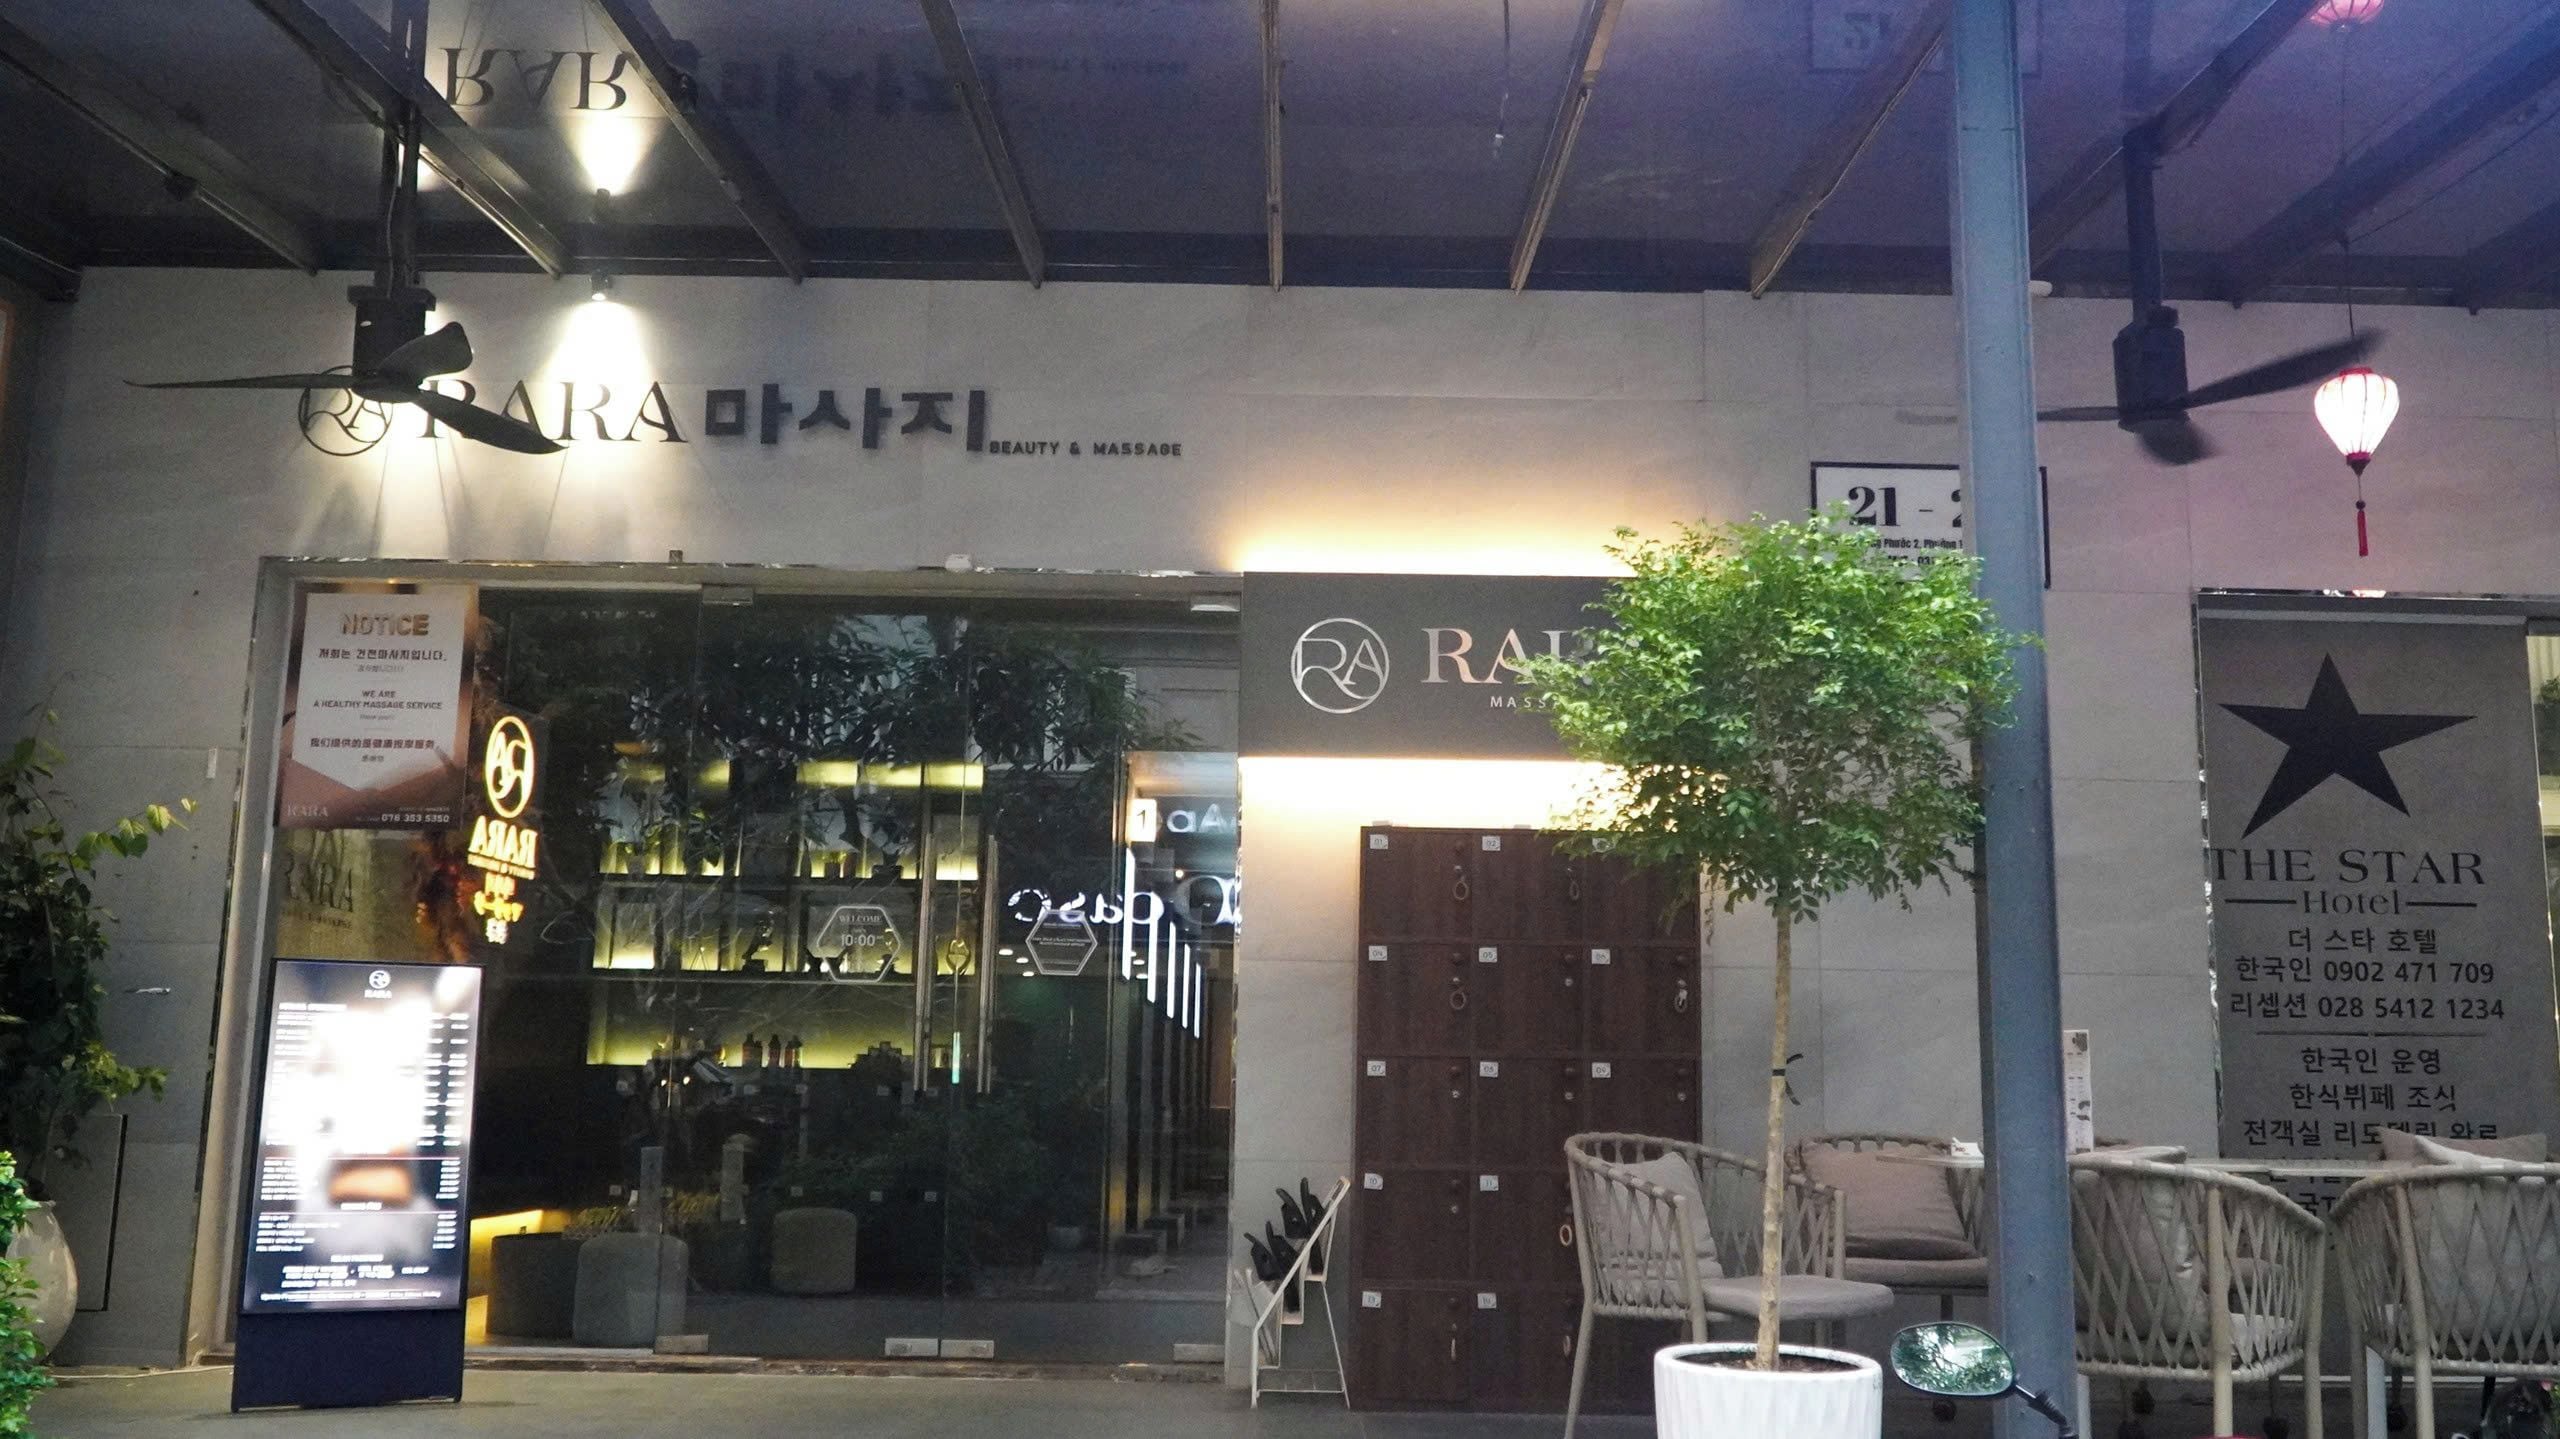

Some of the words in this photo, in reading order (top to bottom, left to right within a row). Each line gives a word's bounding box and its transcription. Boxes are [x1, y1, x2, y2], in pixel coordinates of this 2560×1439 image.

[705, 383, 986, 452] 마사지
[989, 440, 1060, 455] BEAUTY
[1069, 441, 1081, 455] &
[1093, 442, 1182, 457] MASSAGE
[1848, 486, 1901, 526] 21
[342, 613, 430, 636] NOTICE
[313, 700, 320, 708] A
[321, 700, 362, 709] HEALTHY
[363, 701, 404, 709] MASSAGE
[406, 701, 443, 710] SERVICE
[362, 690, 376, 698] WE
[378, 691, 396, 699] ARE
[2206, 848, 2315, 883] THE
[2338, 849, 2485, 885] STAR
[2302, 889, 2401, 915] Hotel
[841, 934, 876, 947] 10:00
[2288, 927, 2312, 953] 더
[2324, 928, 2375, 954] 스타
[2387, 928, 2438, 955] 호텔
[2235, 956, 2313, 984] 한국인
[2324, 962, 2384, 983] 0902
[2394, 962, 2437, 983] 471
[2450, 963, 2495, 984] 709
[2231, 993, 2308, 1020] 리셉션
[2318, 996, 2364, 1018] 028
[2375, 997, 2434, 1019] 5412
[2447, 998, 2505, 1021] 1234
[2301, 1047, 2379, 1075] 한국인
[2390, 1048, 2442, 1076] 운영
[2289, 1084, 2395, 1111] 한식뷔페
[2407, 1085, 2457, 1112] 조식
[2243, 1120, 2321, 1147] 전객실
